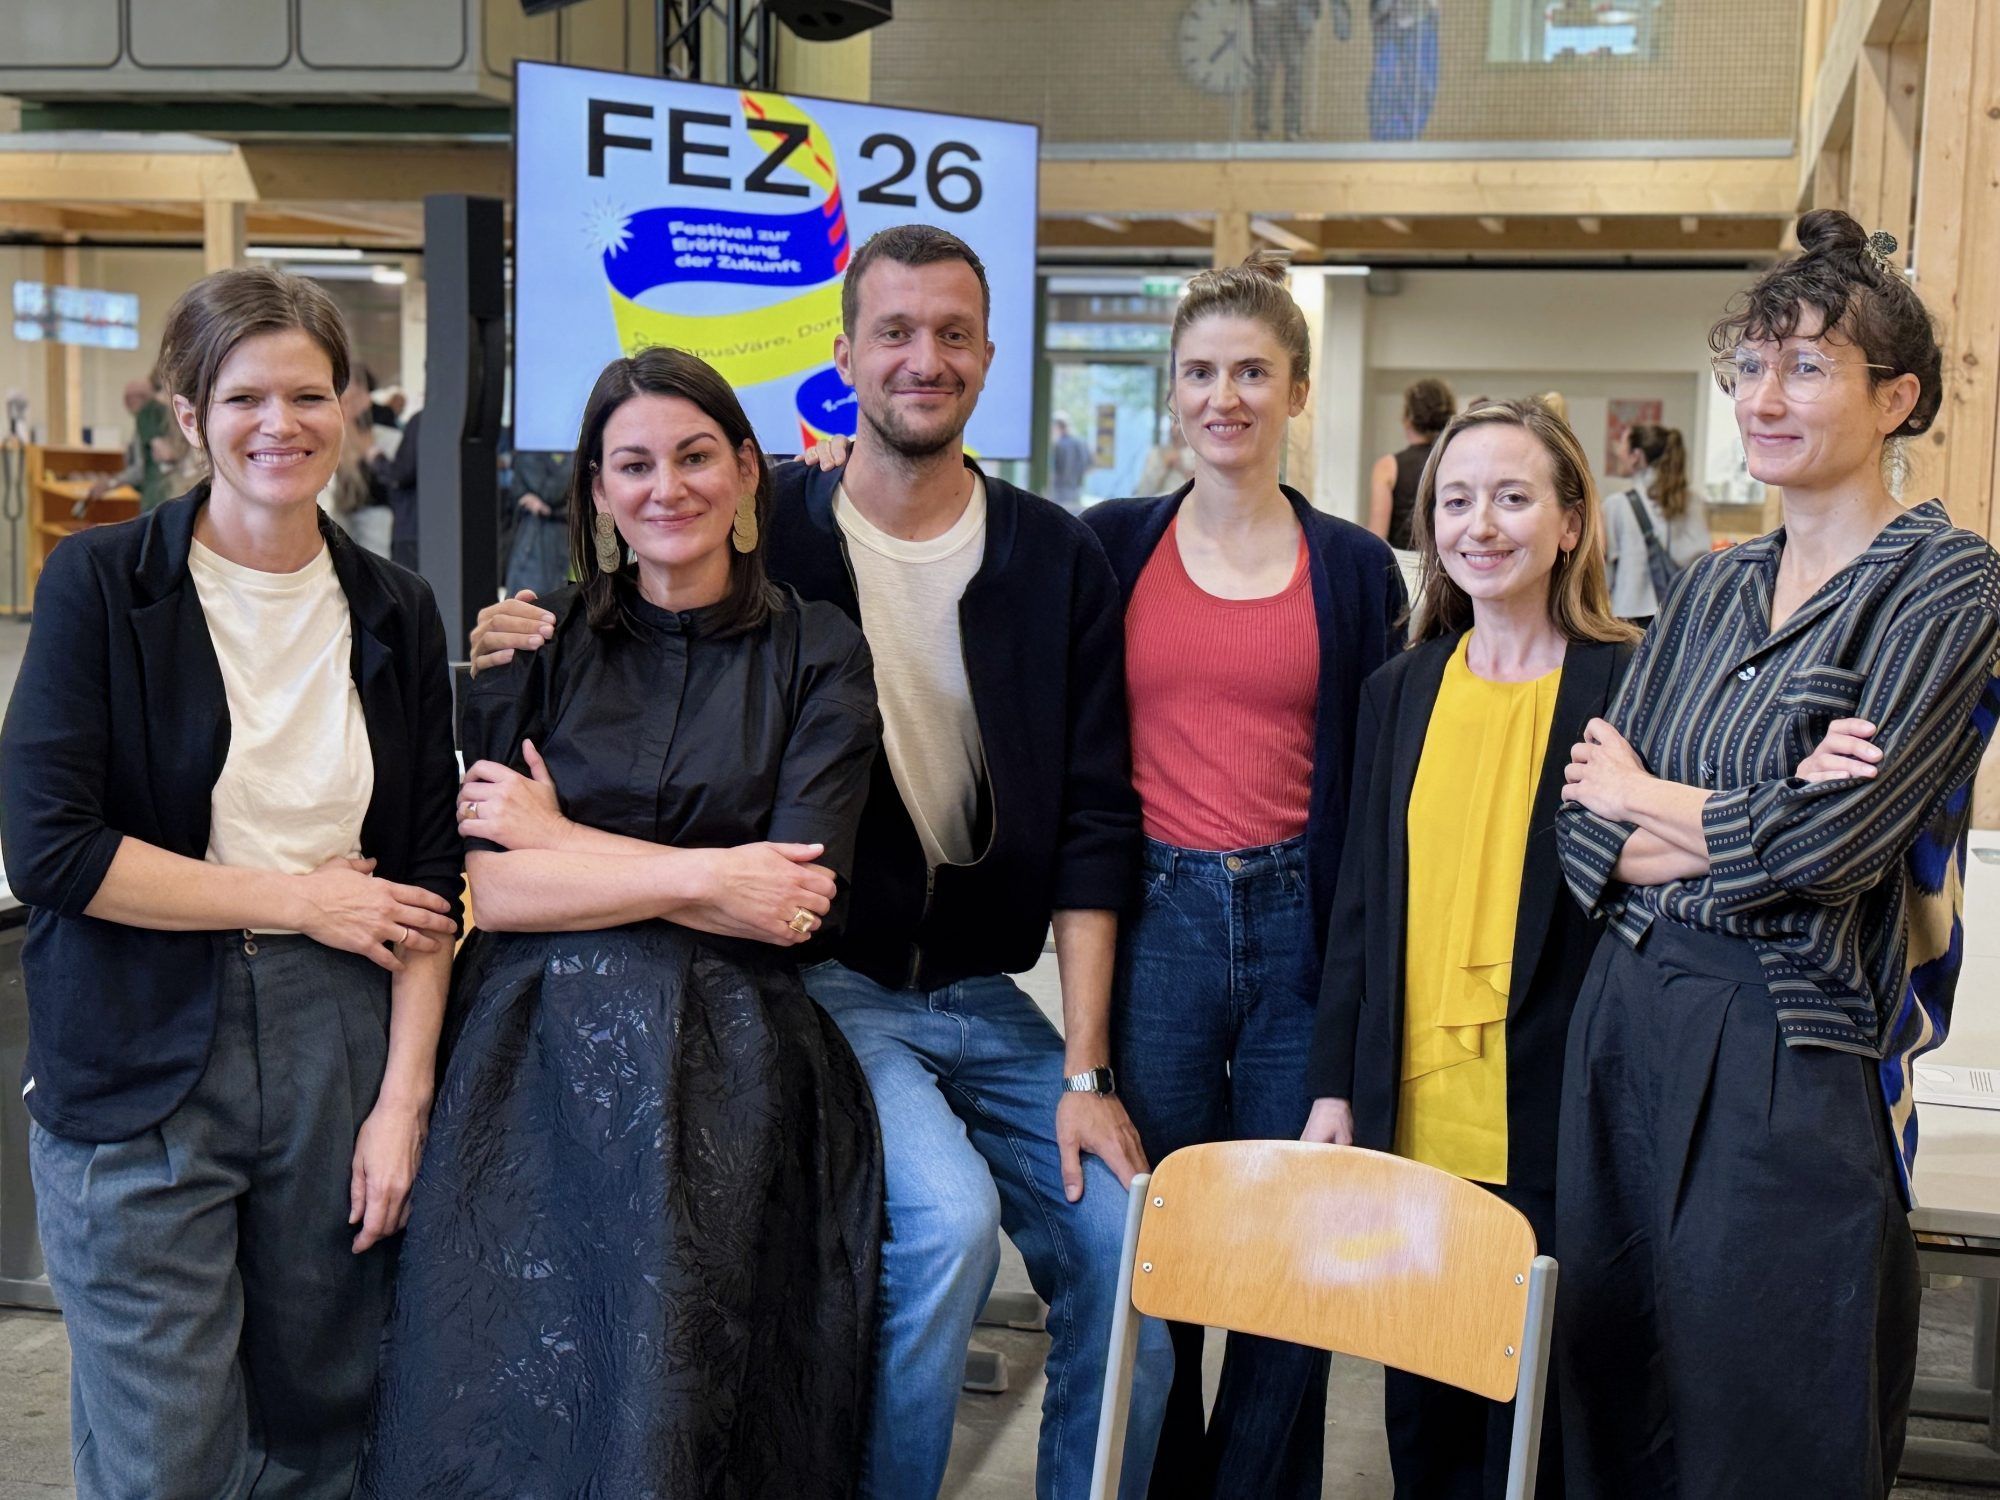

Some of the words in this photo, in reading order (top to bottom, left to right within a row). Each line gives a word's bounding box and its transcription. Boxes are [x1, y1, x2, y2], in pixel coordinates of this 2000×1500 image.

[587, 98, 811, 198] FEZ
[857, 132, 983, 214] 26
[668, 221, 753, 240] Festival
[756, 229, 791, 242] zur
[671, 236, 782, 260] Eröffnung
[674, 252, 713, 268] der
[716, 254, 802, 273] Zukunft
